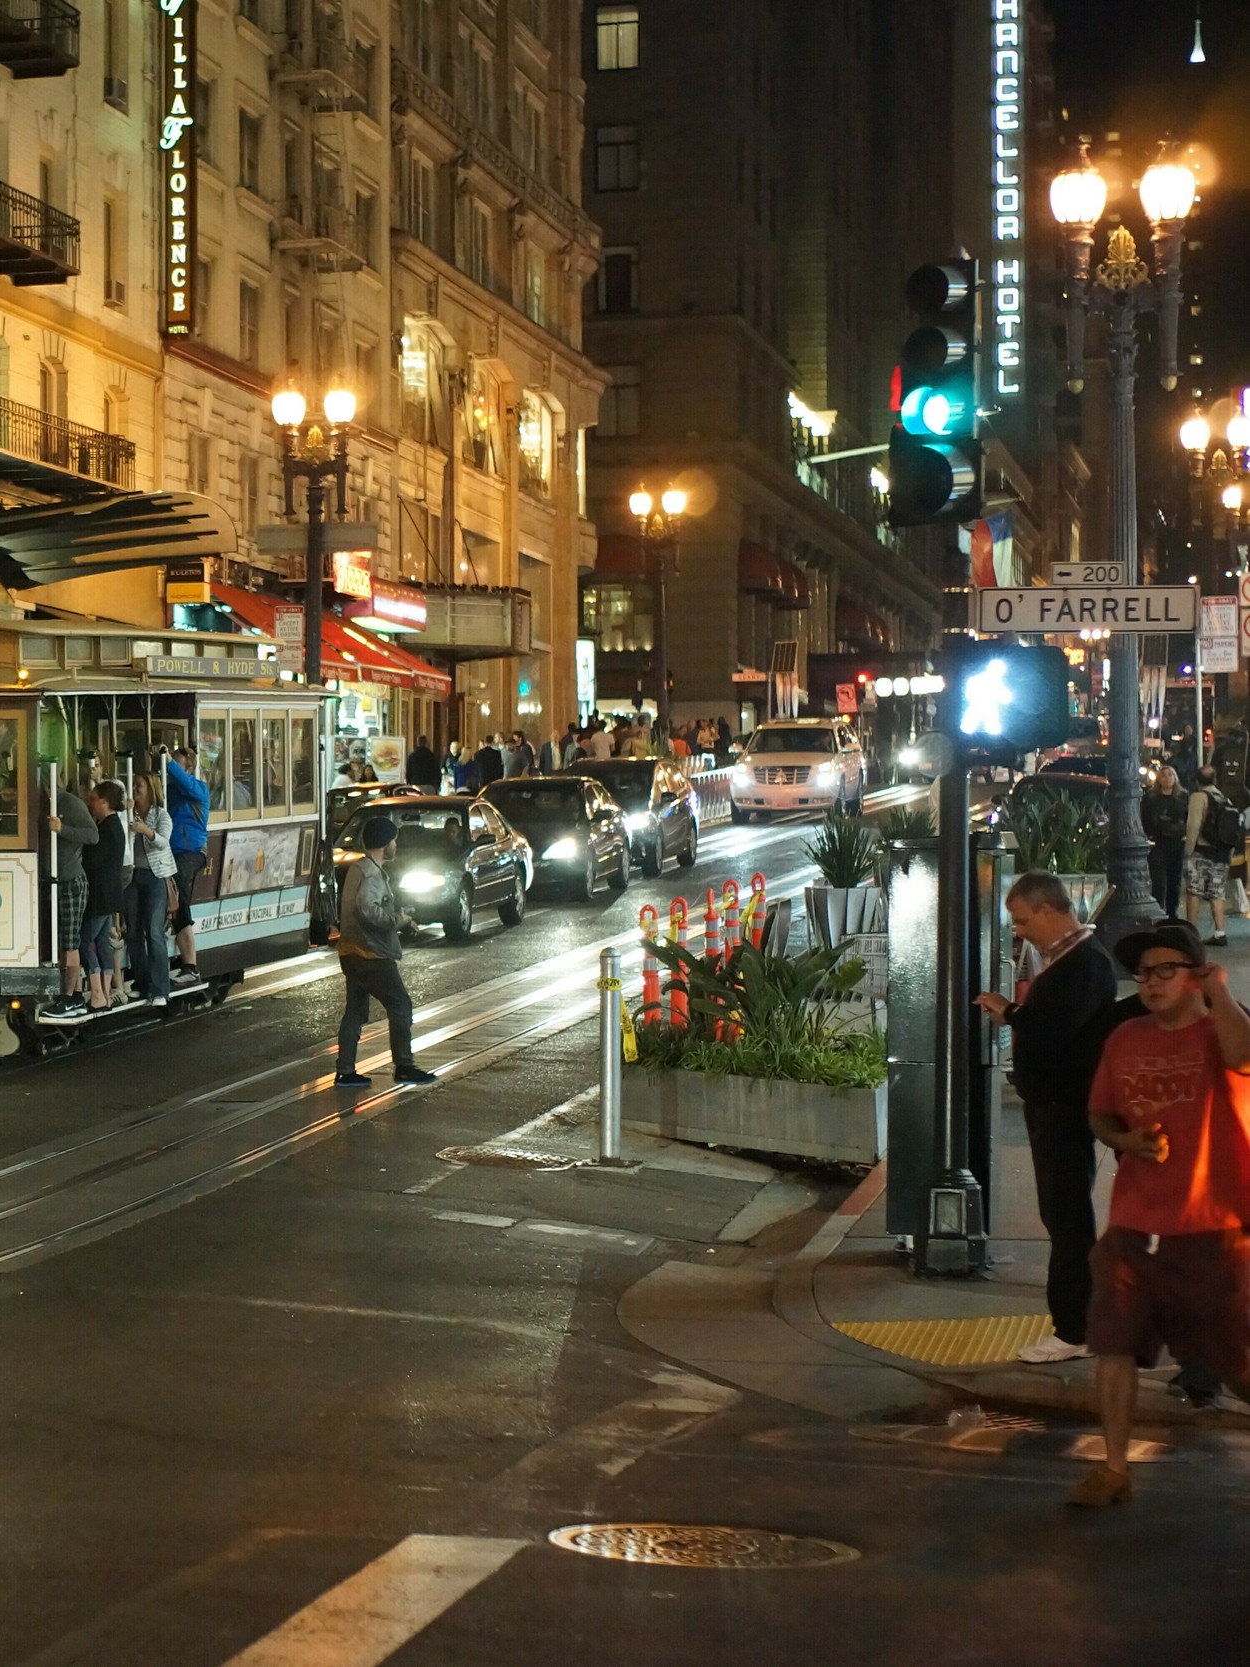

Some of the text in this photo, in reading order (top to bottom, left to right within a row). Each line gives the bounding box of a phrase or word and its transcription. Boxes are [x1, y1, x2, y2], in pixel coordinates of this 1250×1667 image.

[160, 116, 193, 313] FLORENCE
[168, 326, 189, 334] HOTEL
[996, 259, 1021, 395] HOTEL
[1083, 566, 1120, 582] 200
[996, 594, 1181, 623] O' FARRELL
[157, 659, 205, 674] POWELL
[212, 661, 221, 675] &
[227, 662, 255, 675] HYDE
